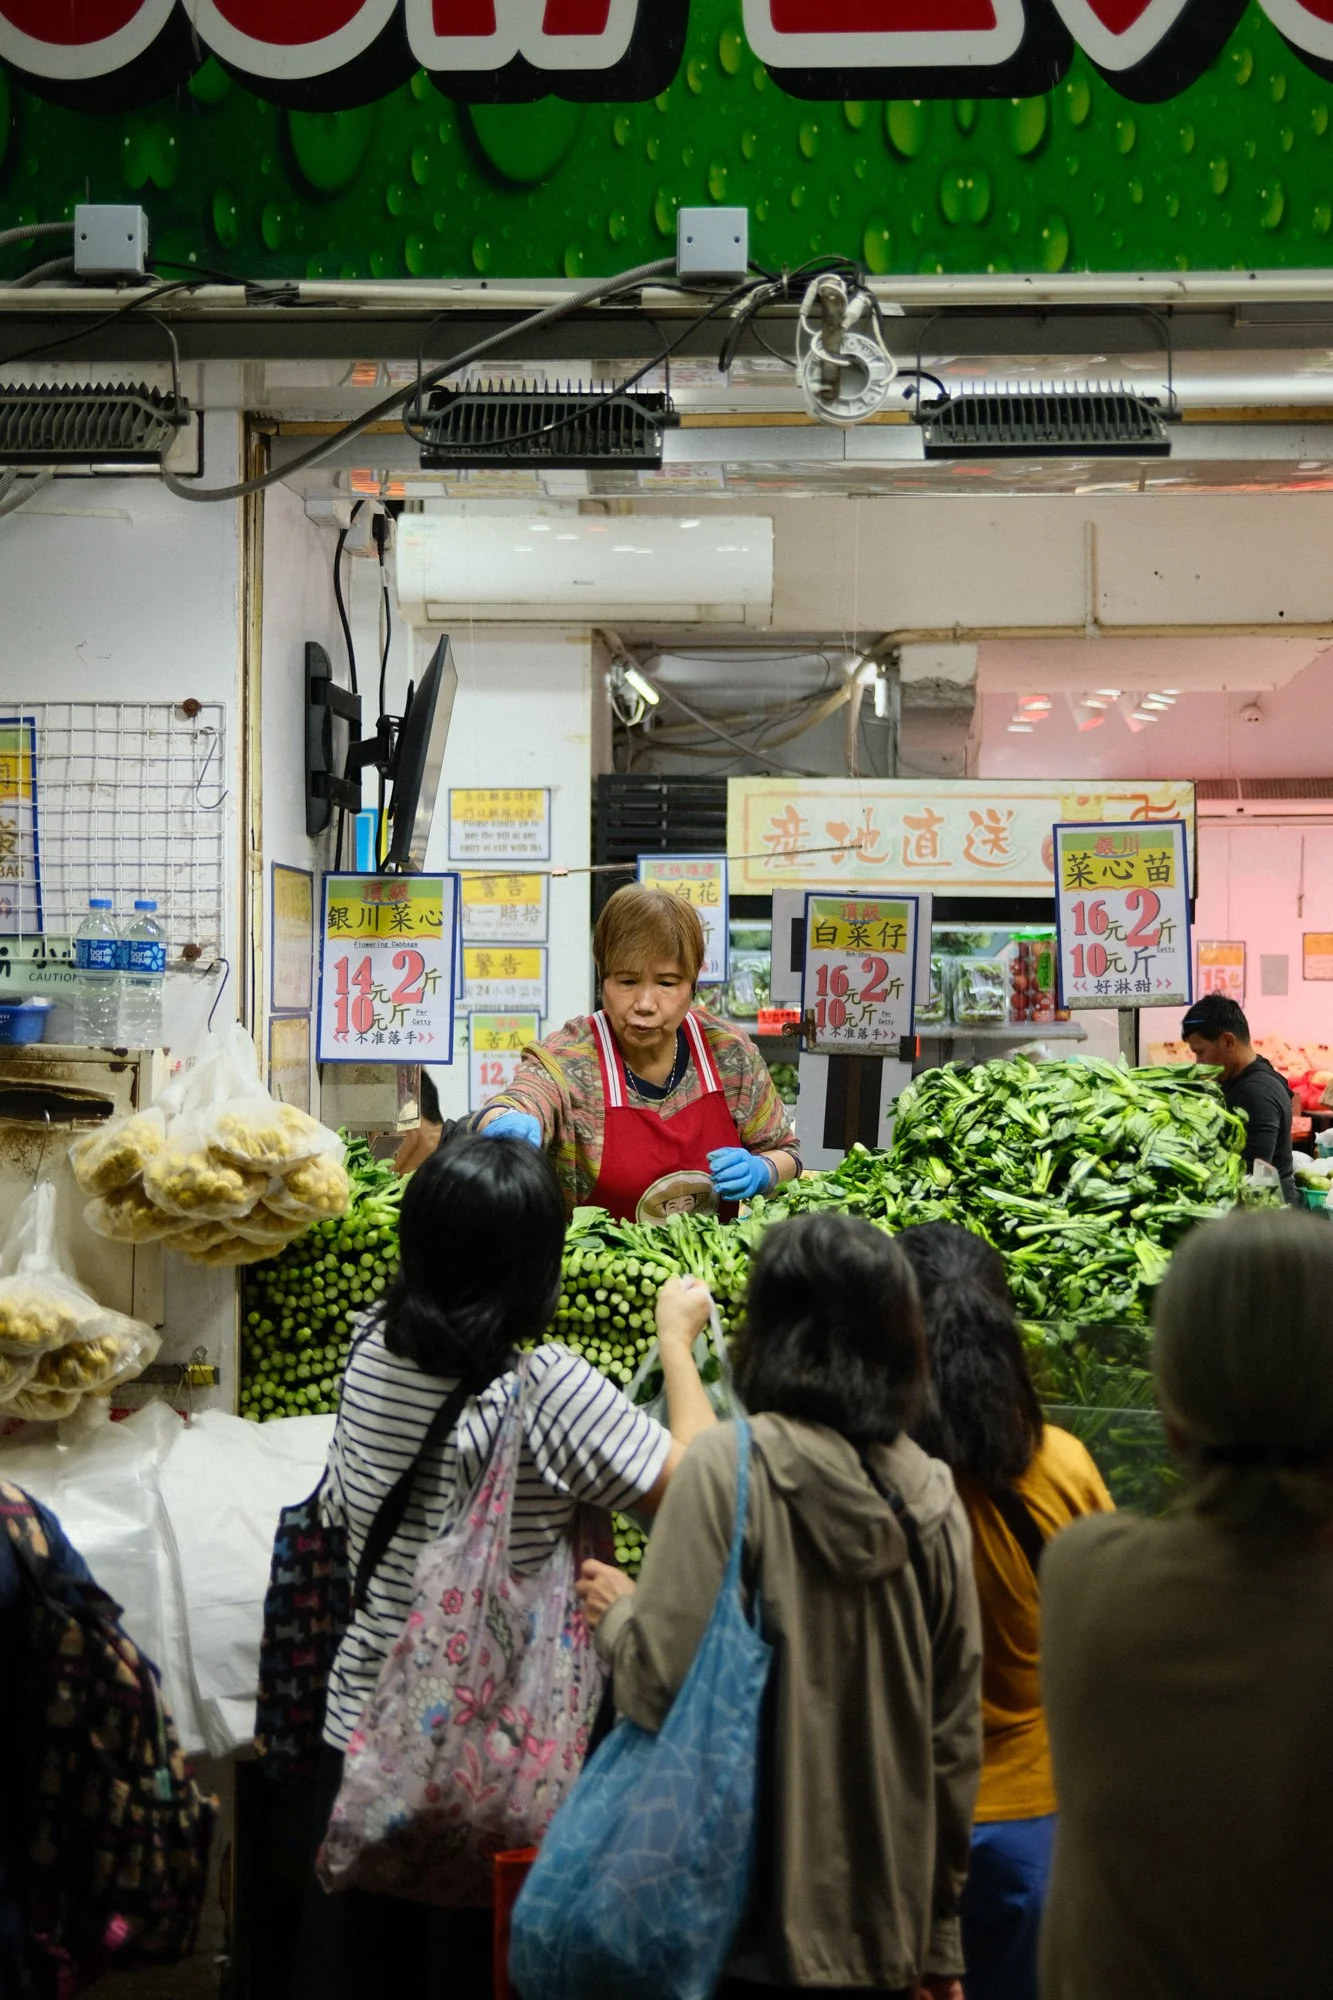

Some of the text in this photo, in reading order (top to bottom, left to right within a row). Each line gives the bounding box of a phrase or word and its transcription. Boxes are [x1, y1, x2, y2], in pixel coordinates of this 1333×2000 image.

[1065, 852, 1172, 887] 菜心苗
[656, 882, 718, 904] 白花
[328, 904, 444, 932] 銀川菜心
[815, 919, 907, 949] 白菜仔
[474, 952, 522, 976] 警告
[415, 1008, 428, 1016] Per
